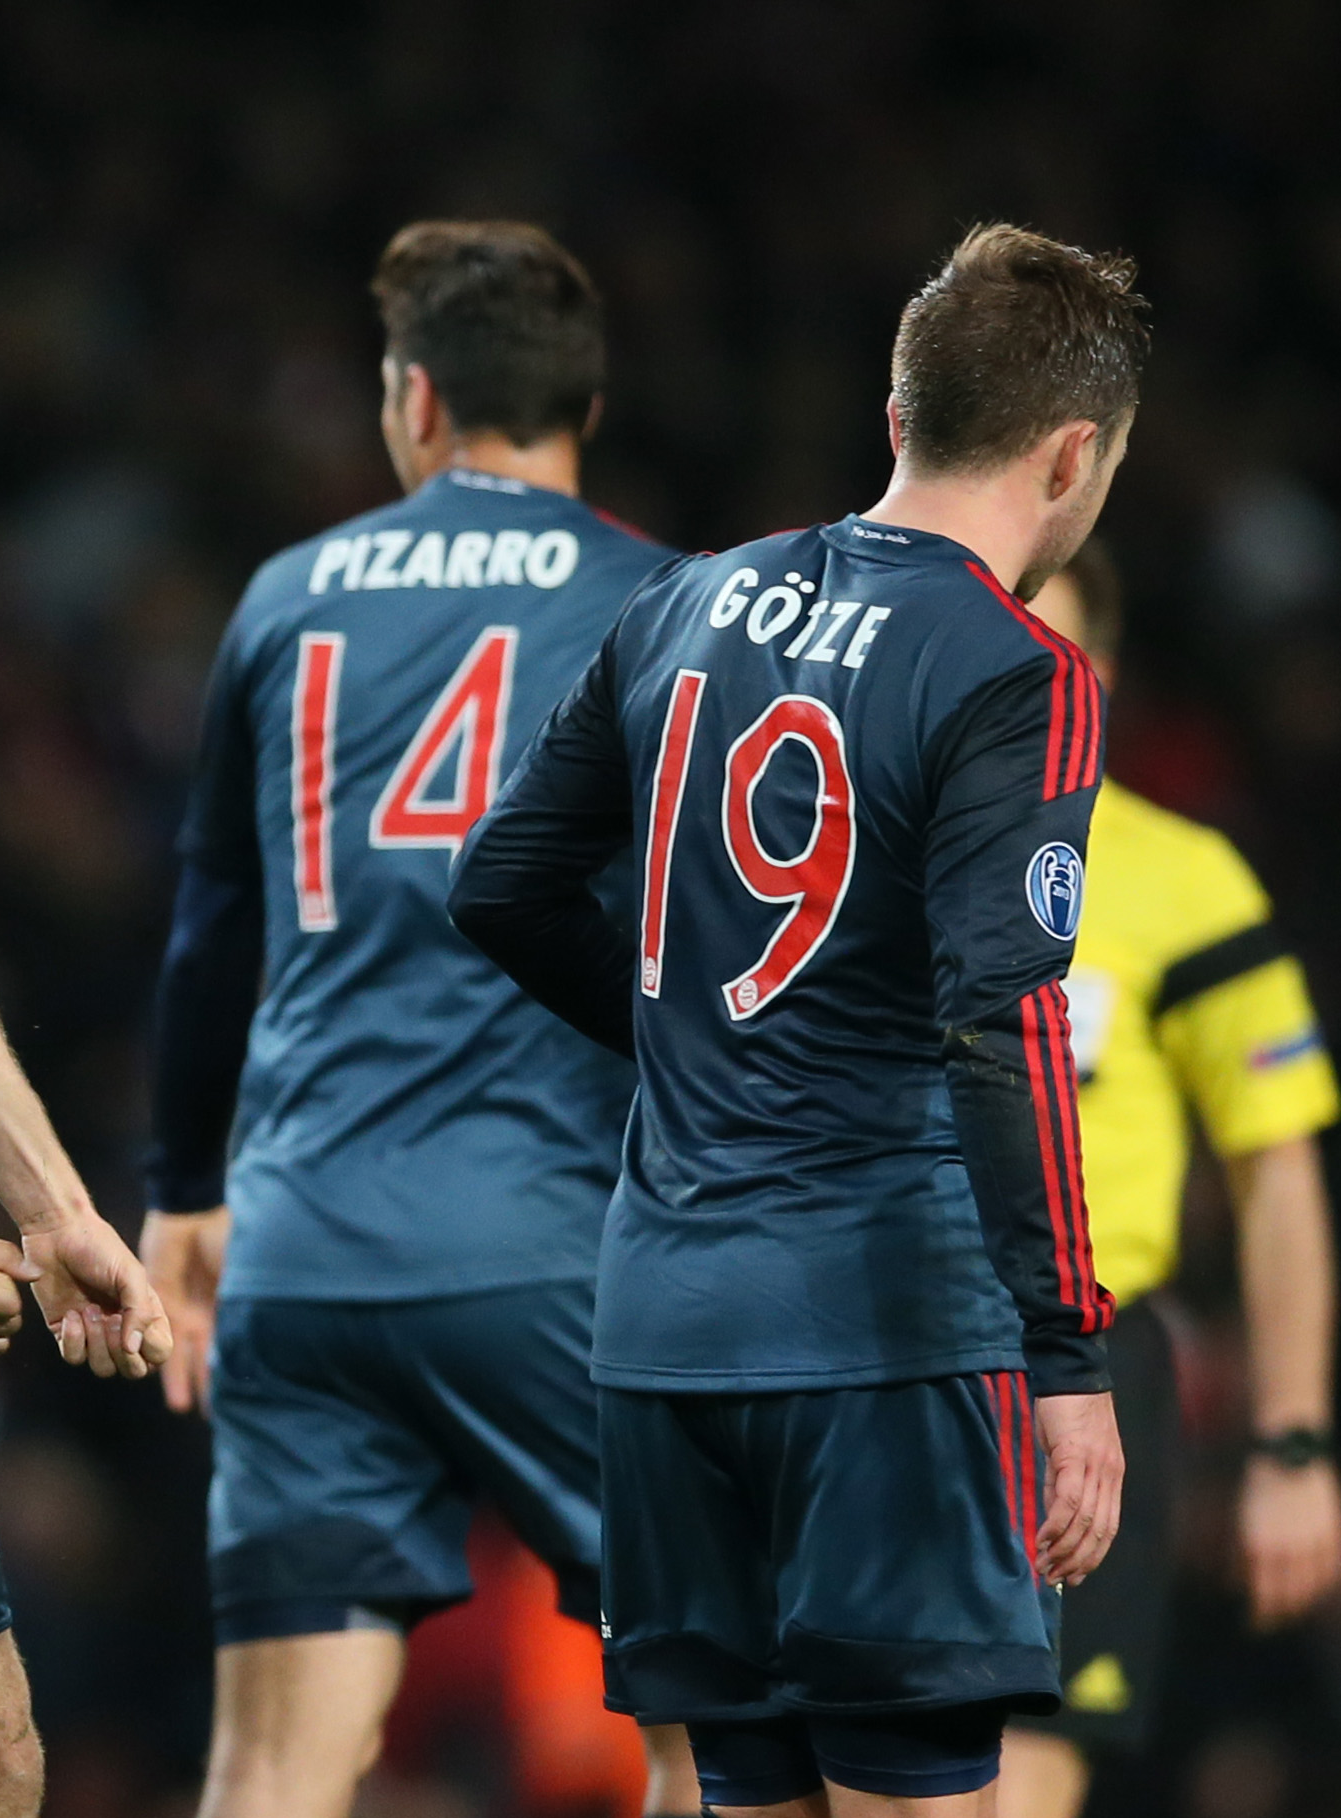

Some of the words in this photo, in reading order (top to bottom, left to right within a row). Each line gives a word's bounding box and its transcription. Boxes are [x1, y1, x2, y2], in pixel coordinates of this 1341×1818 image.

[308, 529, 579, 596] PIZARRO
[709, 567, 892, 669] GÖTZE
[292, 625, 520, 934] 14
[639, 668, 858, 1022] 19
